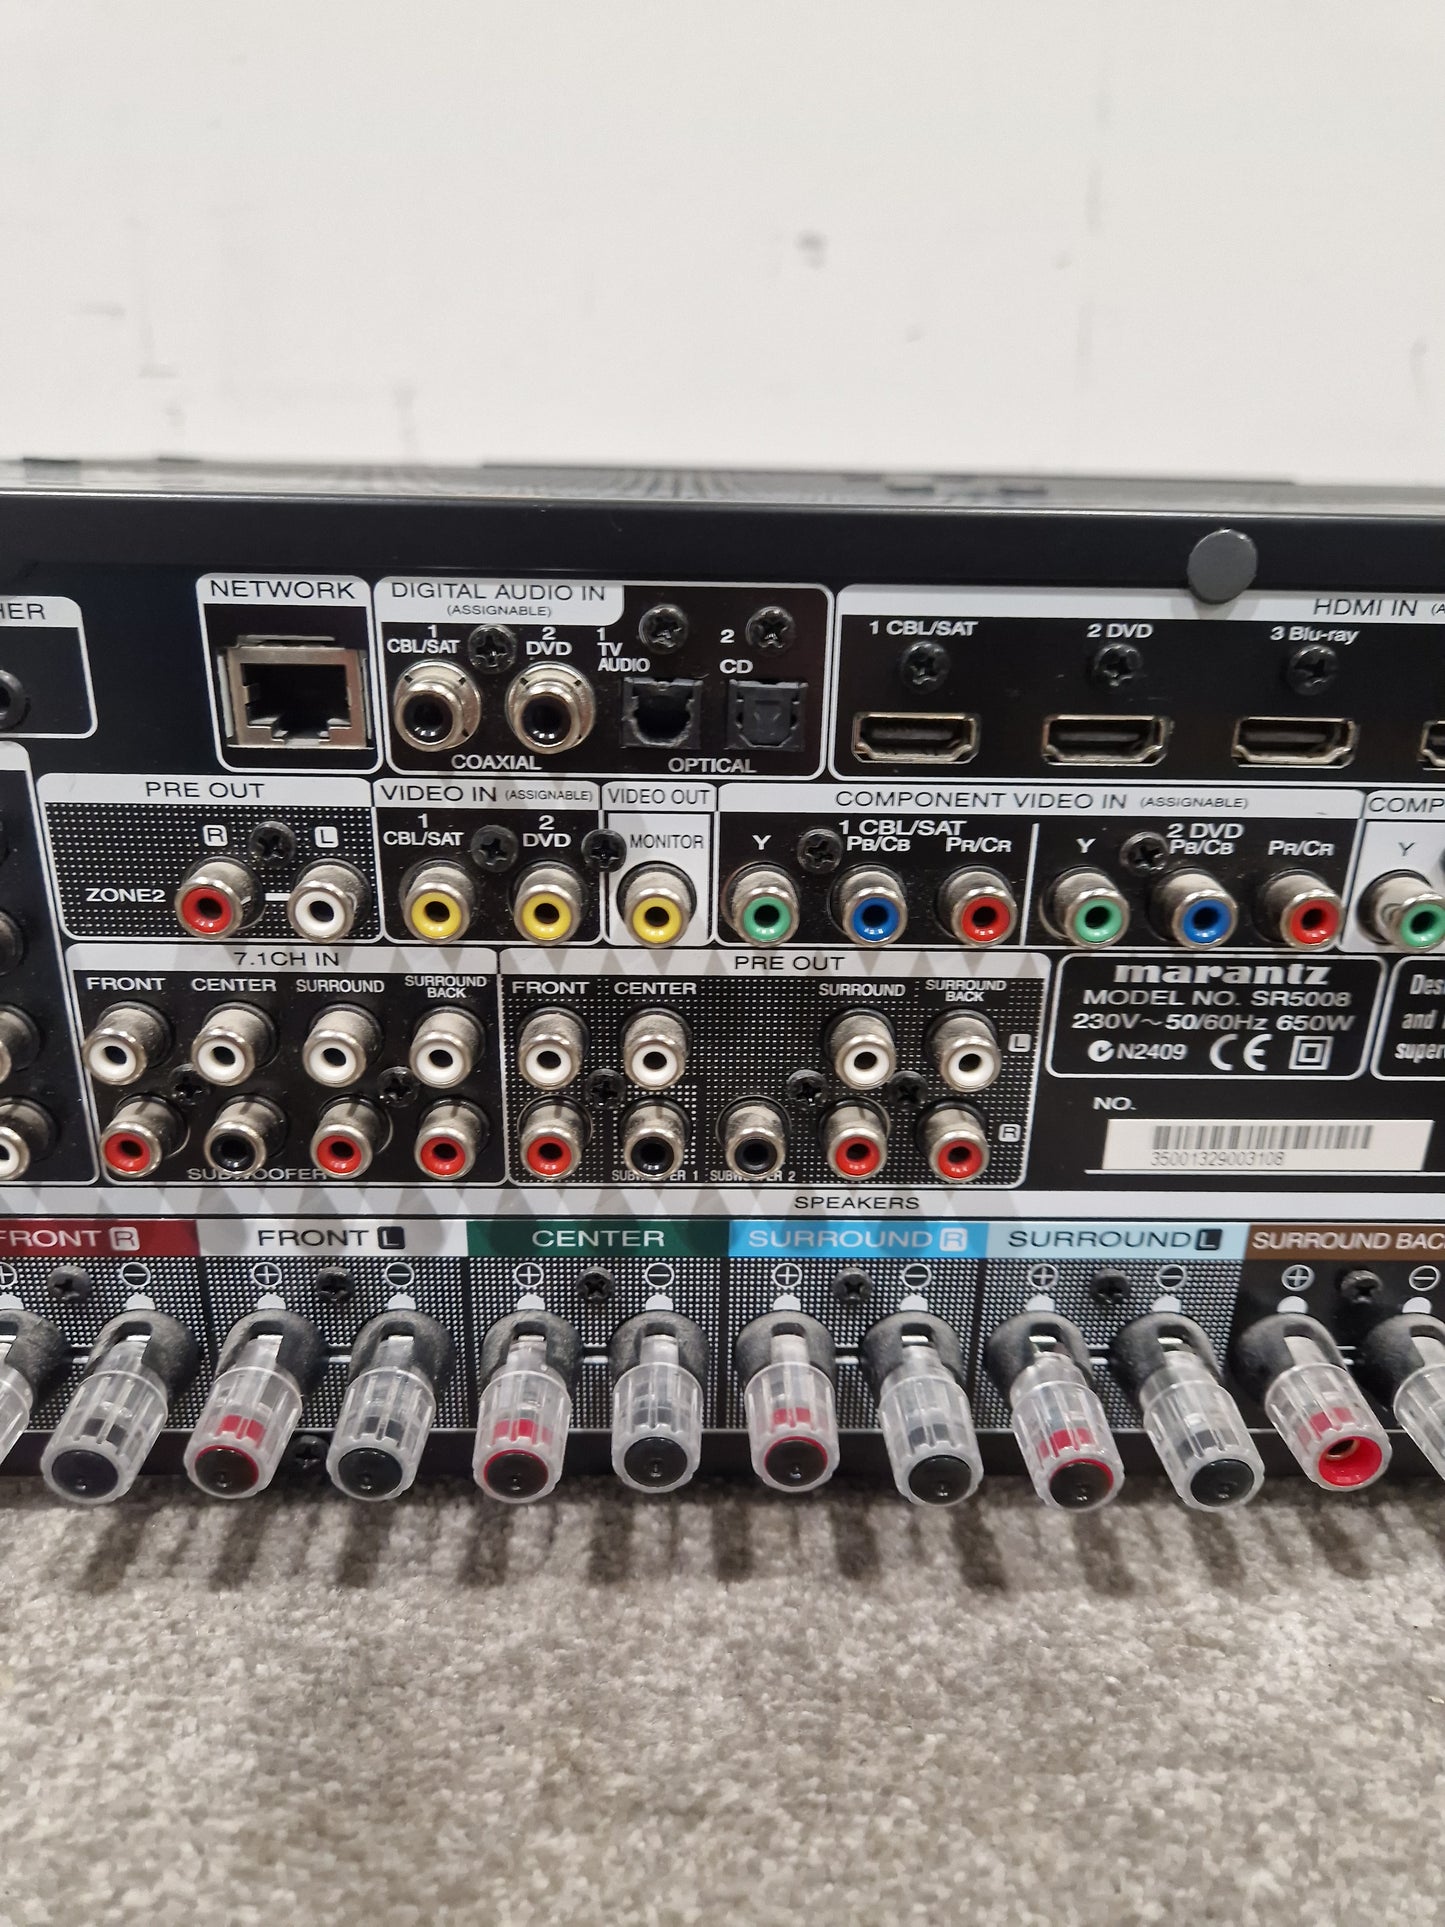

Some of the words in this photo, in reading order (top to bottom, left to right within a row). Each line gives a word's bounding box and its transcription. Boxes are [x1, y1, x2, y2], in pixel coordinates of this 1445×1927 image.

[210, 580, 356, 600] NETWORK
[391, 582, 486, 599] DIGITAL
[495, 585, 573, 601] AUDIO
[582, 586, 605, 601] IN
[447, 605, 552, 618] (ASSIGNABLE)
[1313, 599, 1381, 616] HDMI
[1391, 599, 1418, 616] IN
[428, 625, 438, 638] 1
[542, 626, 556, 640] 2
[597, 627, 606, 641] 1
[868, 621, 879, 635] 1
[886, 620, 978, 636] CBL/SAT
[1087, 624, 1101, 638] 2
[1106, 624, 1154, 638] DVD
[1270, 626, 1285, 641] 3
[1289, 626, 1360, 645] Blu-ray
[720, 629, 735, 643] 2
[387, 638, 460, 654] CBL/SAT
[526, 641, 572, 656] DVD
[597, 642, 623, 656] TV
[598, 657, 650, 672] AUDIO
[719, 659, 753, 674] CD
[452, 754, 542, 770] COAXIAL
[668, 757, 757, 773] OPTICAL
[146, 781, 199, 798] PRE
[209, 782, 265, 799] OUT
[381, 785, 463, 801] VIDEO
[473, 786, 496, 802] IN
[505, 790, 593, 802] (ASSIGNABLE)
[608, 788, 665, 804] VIDEO
[671, 788, 710, 805] OUT
[836, 790, 1006, 808] COMPONENT
[1014, 793, 1093, 809] VIDEO
[1102, 794, 1127, 809] IN
[1140, 796, 1248, 811] (ASSIGNABLE)
[418, 813, 429, 828] 1
[538, 815, 555, 830] 2
[839, 820, 849, 835] 1
[859, 819, 967, 836] CBL/SAT
[1166, 823, 1184, 839] 2
[1189, 823, 1244, 839] DVD
[383, 831, 464, 847] CBL/SAT
[523, 832, 571, 848] DVD
[630, 834, 704, 849] MONITOR
[753, 834, 771, 850] Y
[1076, 838, 1096, 854] Y
[1398, 842, 1415, 857] Y
[86, 888, 166, 903] ZONE2
[234, 952, 306, 967] 7.1CH
[316, 952, 340, 967] IN
[734, 956, 784, 970] PRE
[792, 956, 845, 971] OUT
[404, 975, 488, 987] SURROUND
[1113, 963, 1331, 984] marantz
[86, 977, 166, 991] FRONT
[191, 978, 276, 992] CENTER
[296, 979, 385, 993] SURROUND
[512, 981, 590, 995] FRONT
[614, 981, 697, 996] CENTER
[818, 983, 906, 997] SURROUND
[925, 979, 1007, 991] SURROUND
[427, 987, 466, 998] BACK
[945, 990, 984, 1002] BACK
[1082, 989, 1186, 1006] MODEL
[1192, 990, 1241, 1006] NO.
[1250, 990, 1352, 1007] SR5008
[1276, 1014, 1356, 1031] 650W
[1401, 1009, 1438, 1030] and
[1117, 1043, 1188, 1060] N2409
[1093, 1096, 1137, 1111] NO.
[692, 1170, 698, 1181] 1
[788, 1170, 796, 1182] 2
[794, 1196, 920, 1210] SPEAKERS
[257, 1229, 370, 1246] FRONT
[532, 1230, 665, 1248] CENTER
[748, 1230, 932, 1249] SURROUND
[1008, 1230, 1191, 1249] SURROUND
[1252, 1232, 1392, 1250] SURROUND
[1395, 1232, 1445, 1250] BAC
